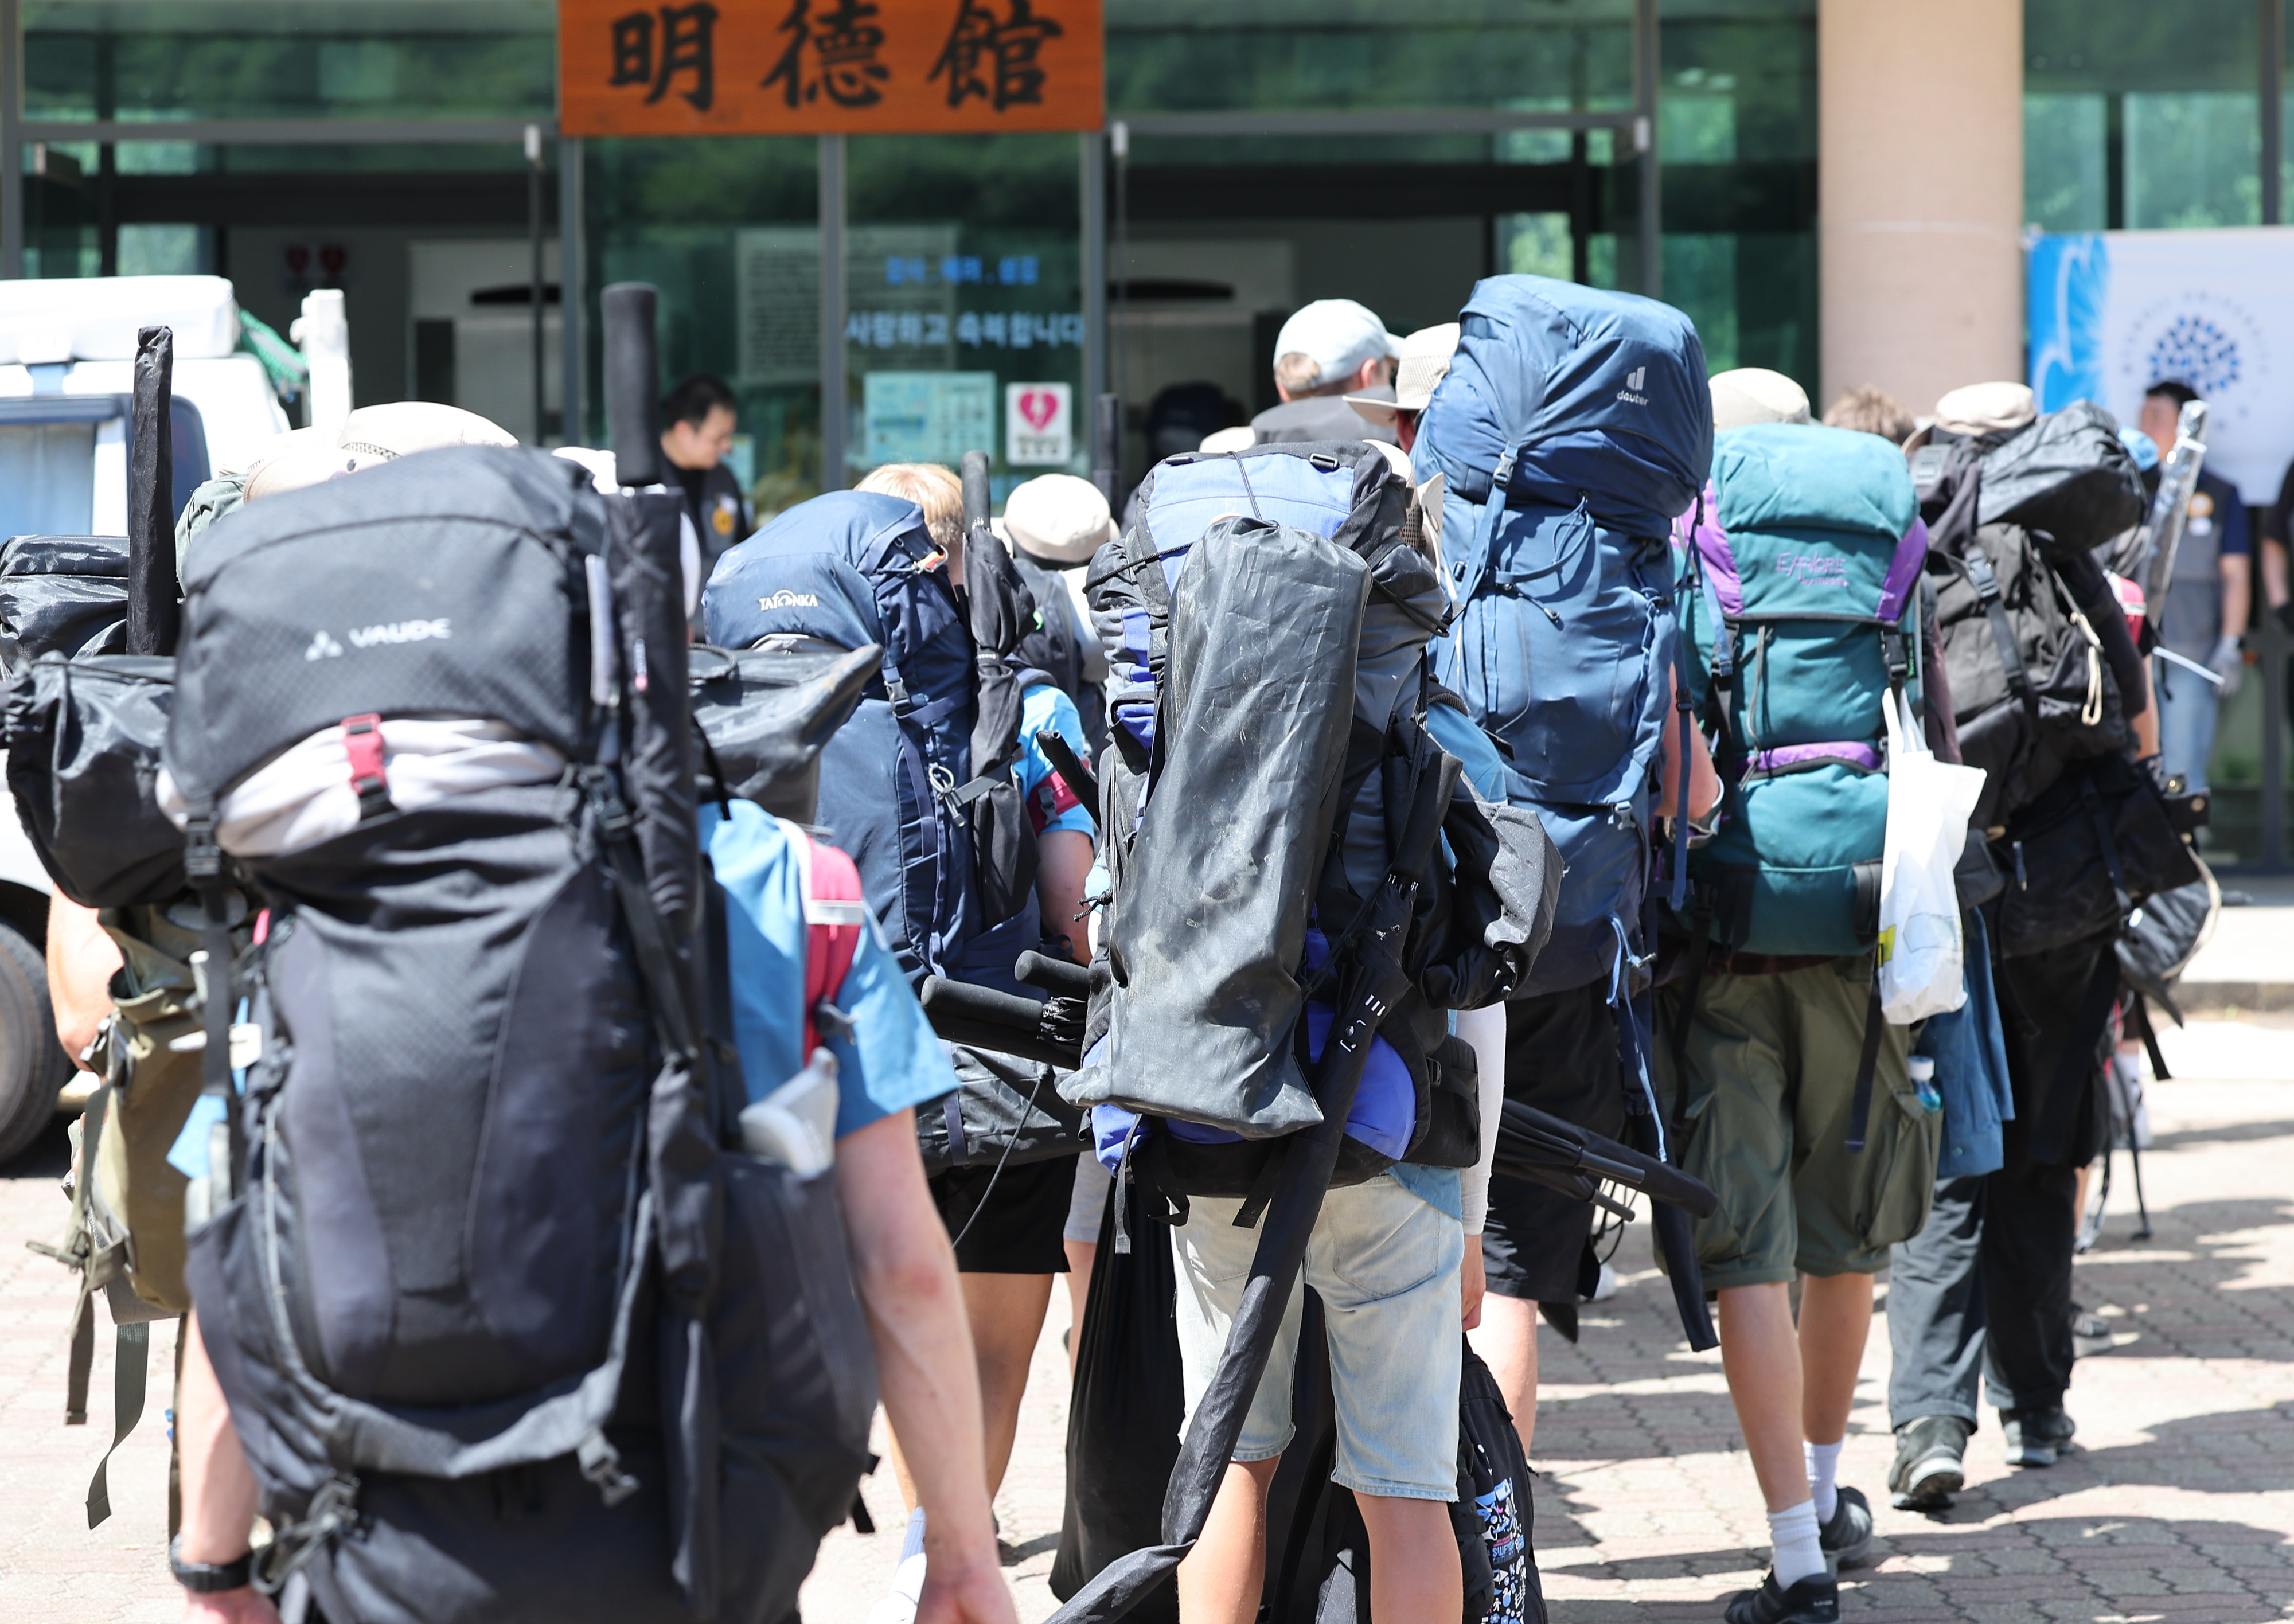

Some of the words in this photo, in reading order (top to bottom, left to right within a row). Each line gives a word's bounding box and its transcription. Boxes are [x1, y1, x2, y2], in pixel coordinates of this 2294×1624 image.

[1616, 390, 1649, 406] deuter
[759, 590, 819, 611] TATONKA
[348, 618, 452, 648] VAUDE
